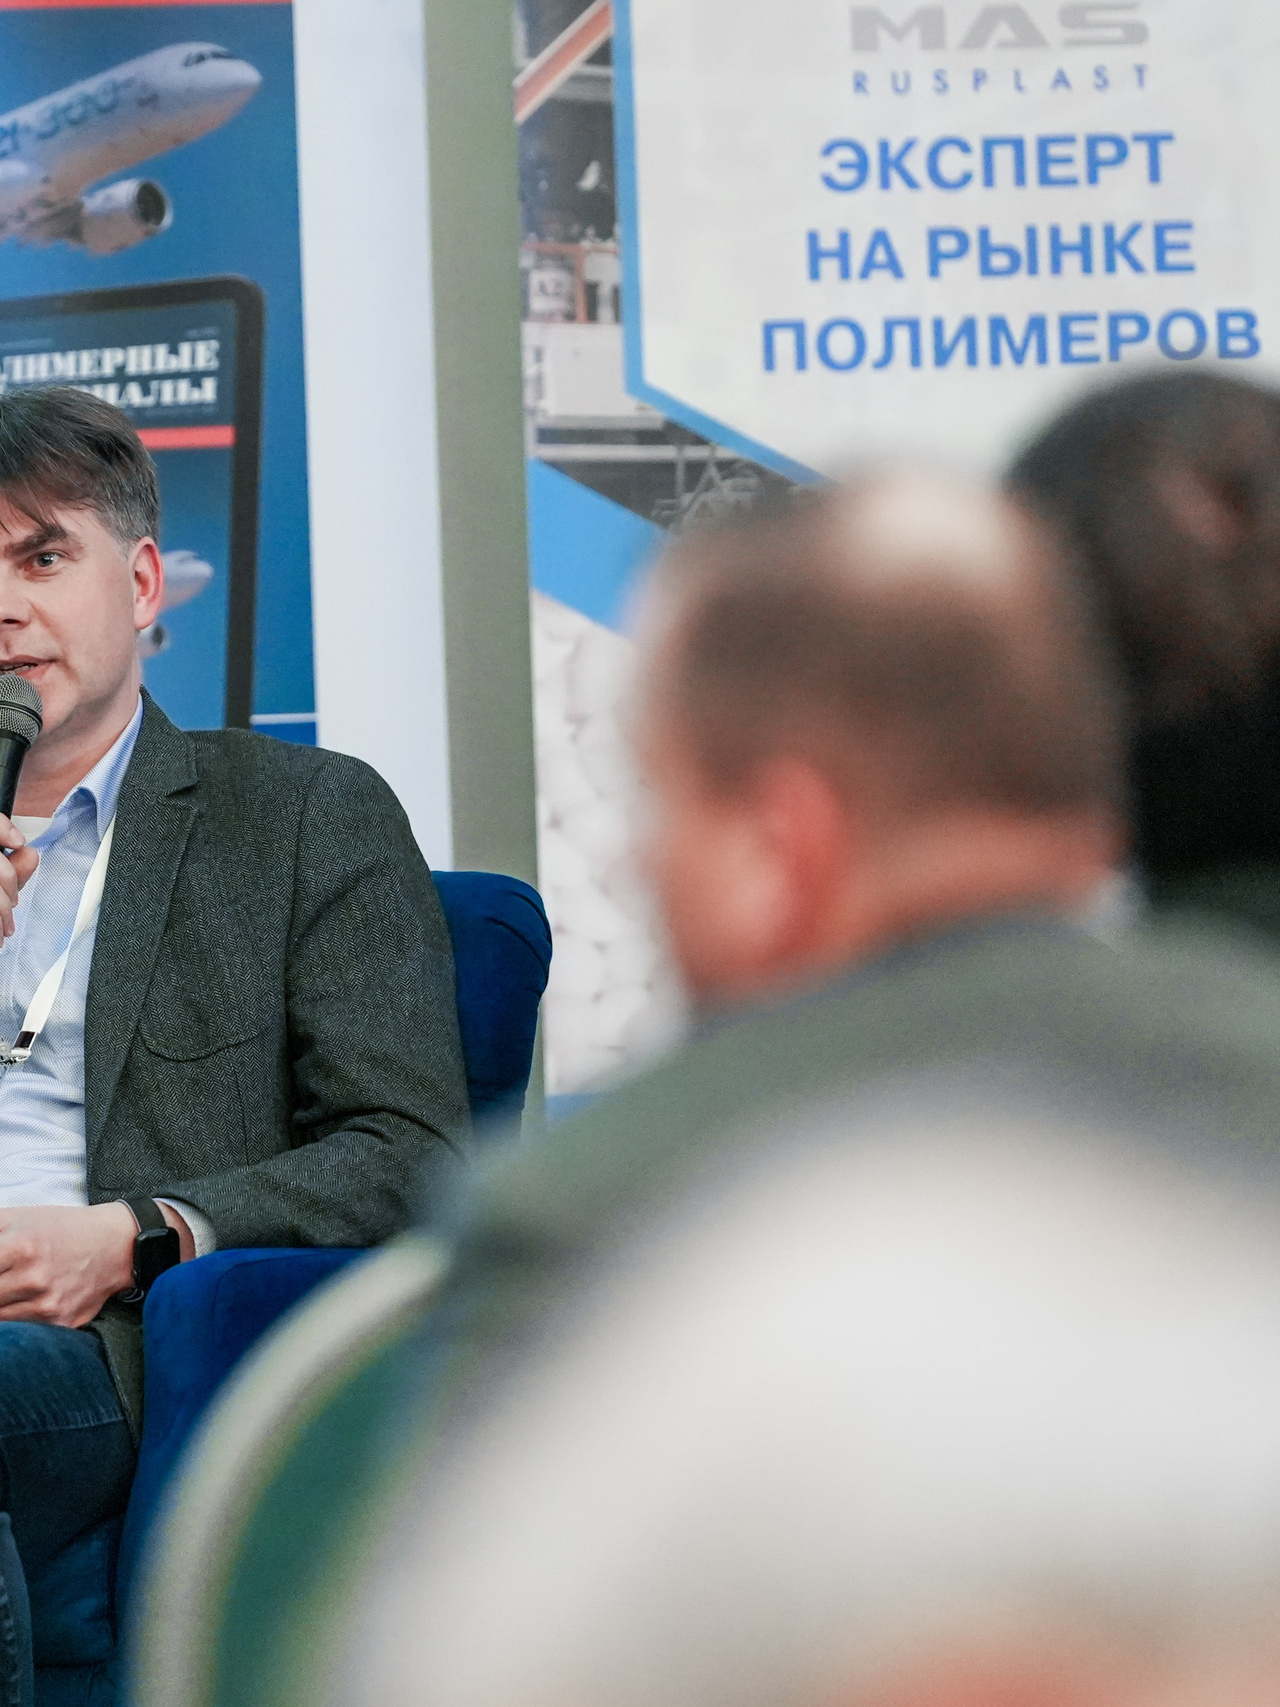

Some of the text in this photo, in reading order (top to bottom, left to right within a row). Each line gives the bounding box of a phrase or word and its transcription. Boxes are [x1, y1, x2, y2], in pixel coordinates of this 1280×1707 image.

[850, 2, 1149, 52] MAS
[852, 63, 1149, 96] RUSPLAST
[820, 132, 1176, 193] ЭКСПЕРТ
[806, 221, 1197, 282] НА РЫНКЕ
[762, 308, 1263, 372] ПОЛИМЕРОВ
